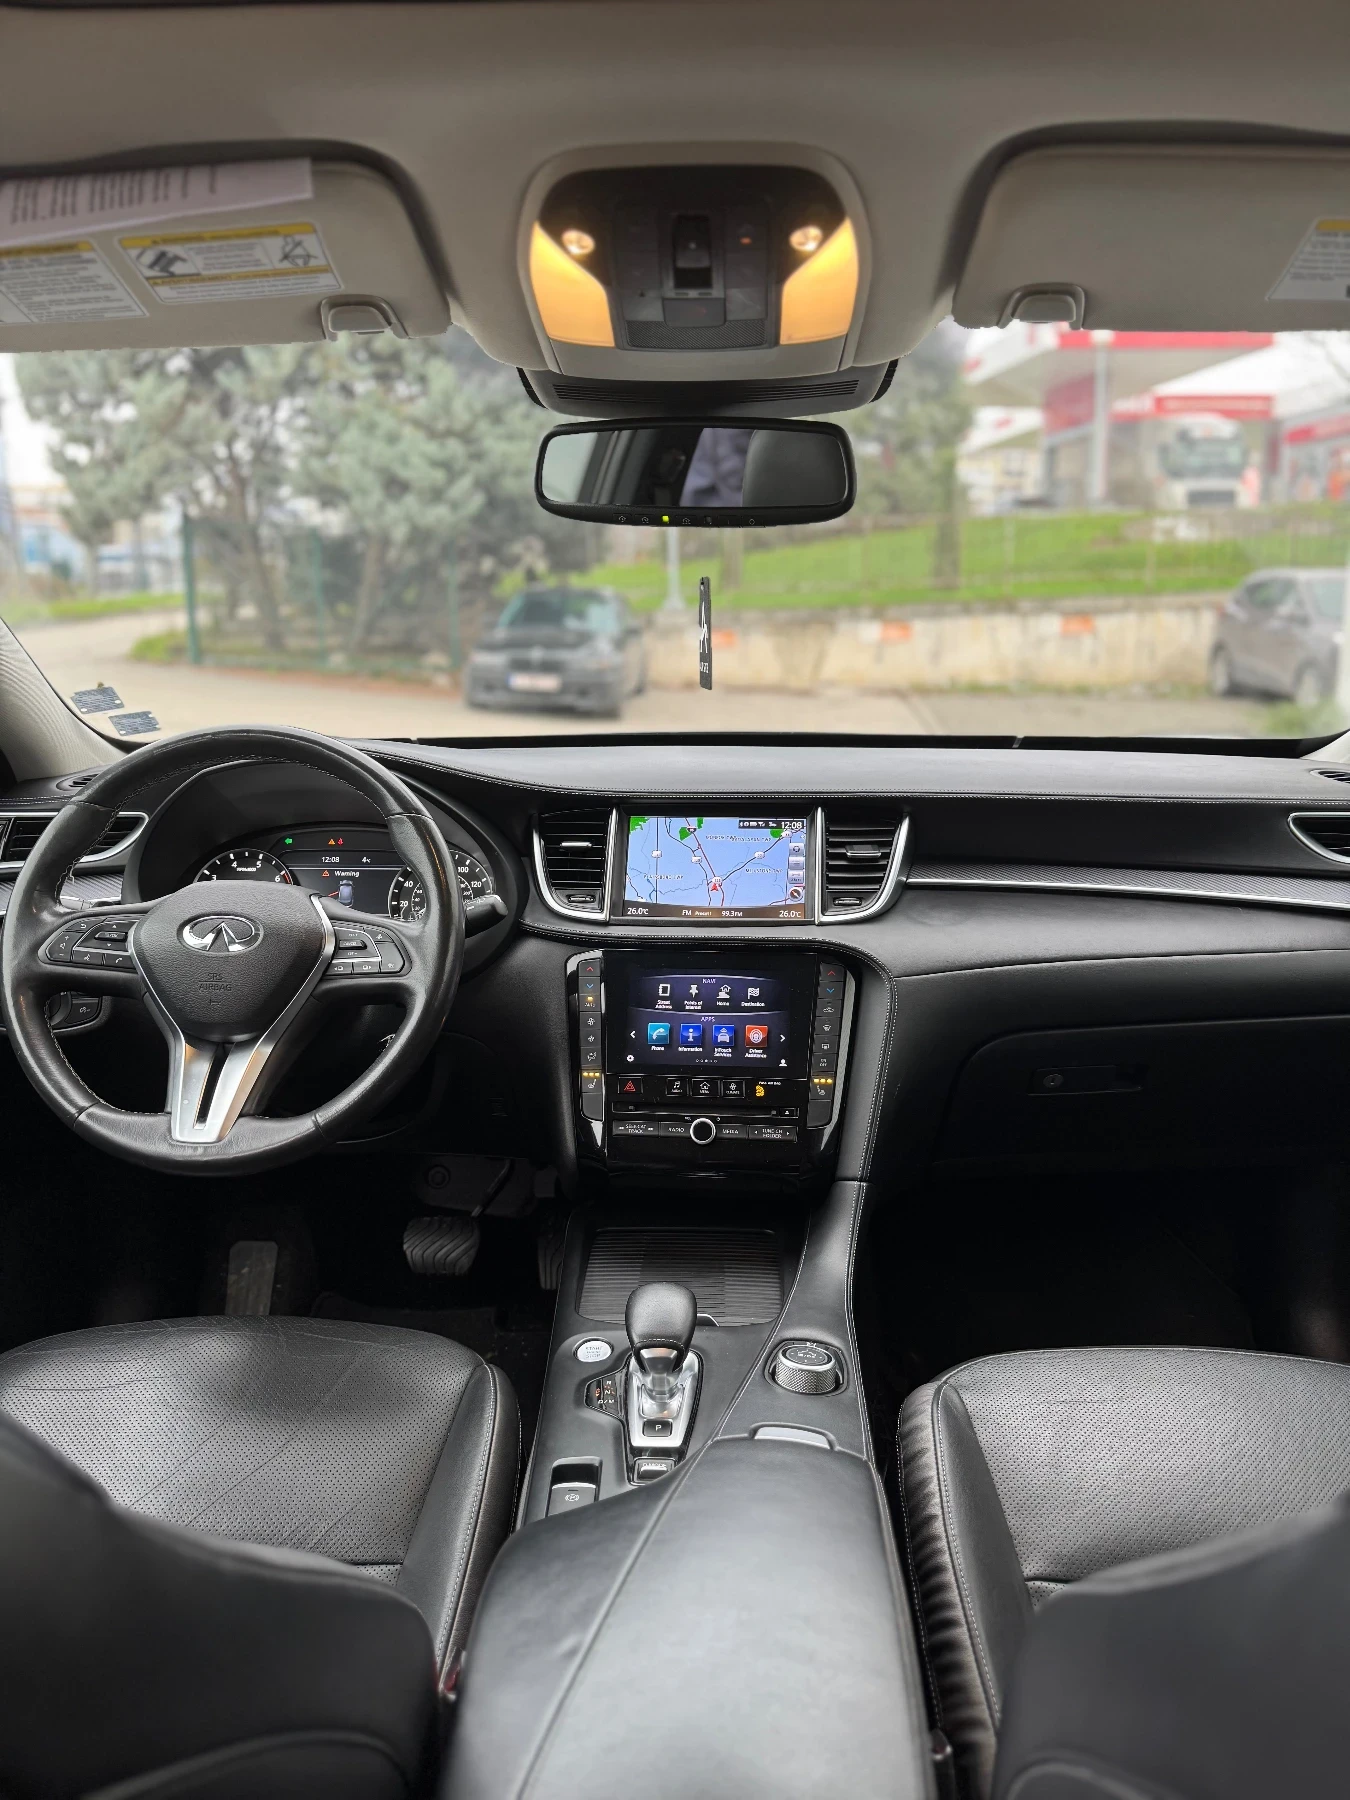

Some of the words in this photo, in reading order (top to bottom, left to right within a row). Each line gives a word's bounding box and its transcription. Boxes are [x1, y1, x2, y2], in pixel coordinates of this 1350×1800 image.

[781, 821, 803, 829] 12:08
[231, 860, 238, 868] 4
[256, 860, 262, 869] 5
[211, 874, 217, 882] 3
[334, 870, 360, 878] Warning
[274, 875, 281, 883] 6
[403, 880, 414, 888] 40
[197, 983, 232, 991] AIRBAG
